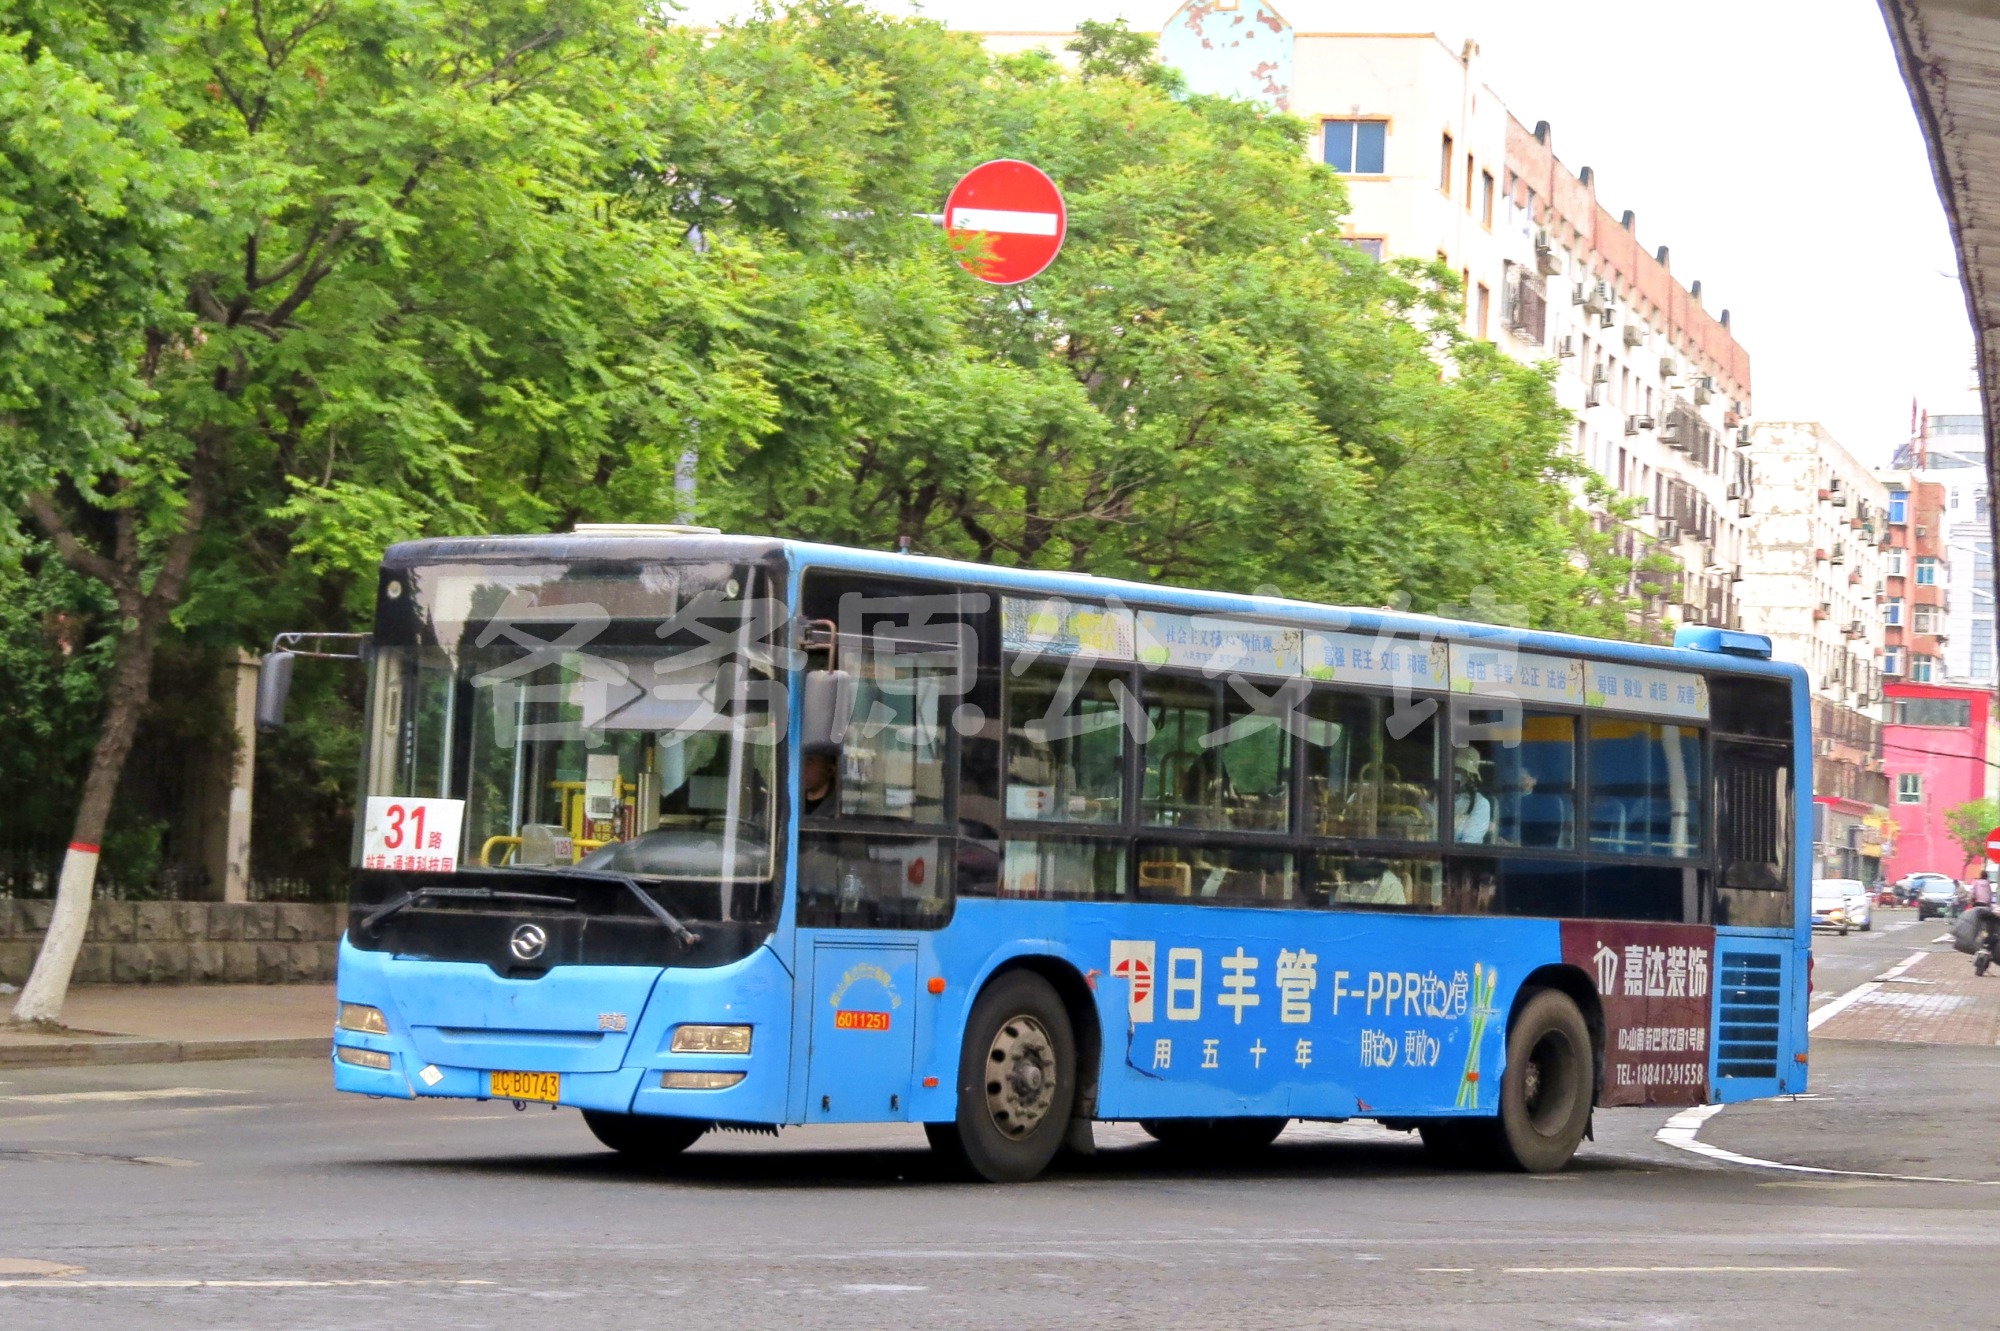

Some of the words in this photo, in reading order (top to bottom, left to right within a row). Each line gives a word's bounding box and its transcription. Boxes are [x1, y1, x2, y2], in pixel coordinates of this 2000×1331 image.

[1324, 646, 1345, 667] 富强
[1352, 648, 1373, 670] 民主
[1380, 650, 1400, 672] 文明
[1407, 654, 1428, 675] 和谐
[1466, 659, 1486, 681] 自由
[1493, 664, 1514, 684] 平等
[1520, 665, 1540, 688] 公正
[1547, 669, 1567, 690] 法治
[1597, 675, 1617, 696] 爱国
[1623, 678, 1642, 699] 敬业
[1648, 681, 1668, 702] 诚信
[1677, 684, 1696, 705] 友善
[1167, 946, 1318, 1025] 日丰管
[1624, 945, 1708, 997] 嘉达装饰
[598, 1013, 628, 1032] 黄海
[837, 1012, 887, 1028] 6011251
